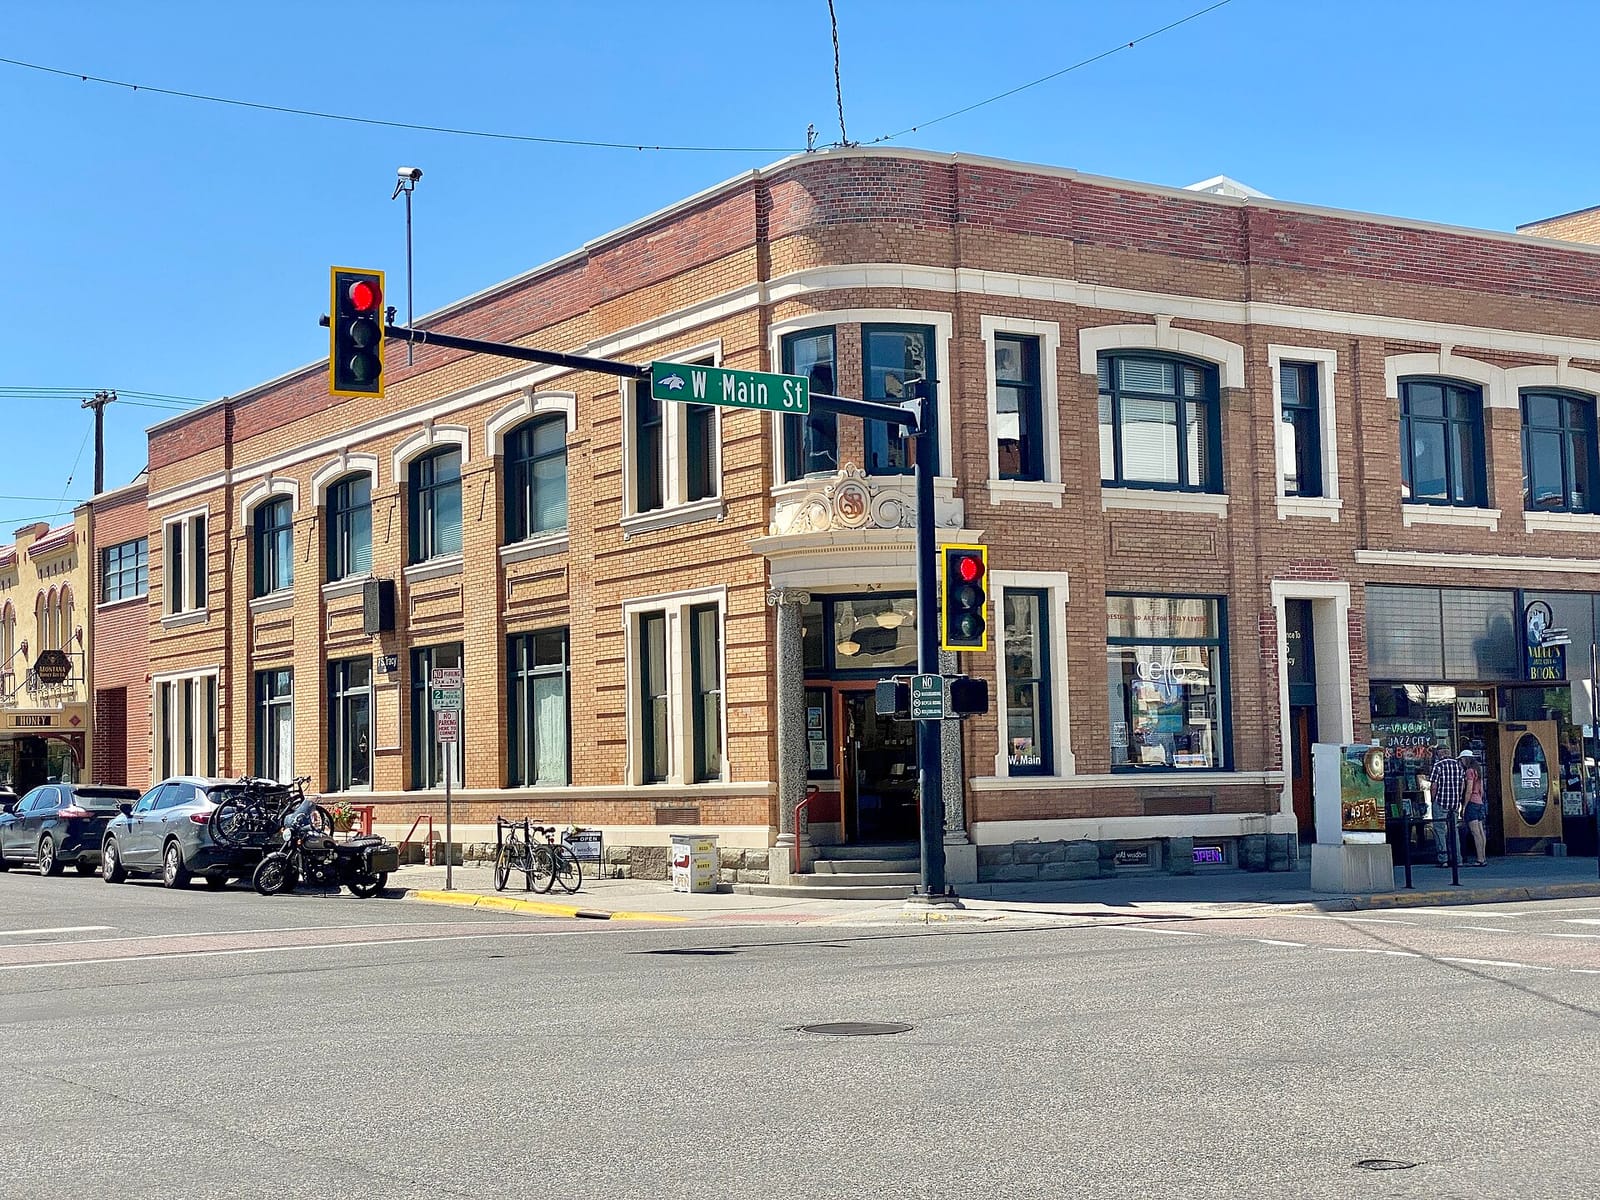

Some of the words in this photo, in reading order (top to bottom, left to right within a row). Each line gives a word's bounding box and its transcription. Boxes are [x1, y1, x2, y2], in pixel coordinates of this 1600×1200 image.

[691, 370, 707, 399] W
[722, 373, 768, 405] Main
[782, 379, 803, 408] St
[1137, 648, 1185, 696] cello
[1530, 666, 1560, 680] BOOKS
[922, 675, 933, 688] NO
[435, 690, 441, 698] 2
[21, 716, 46, 726] HONEY
[1412, 736, 1431, 746] CITY
[1193, 850, 1219, 862] OPEN
